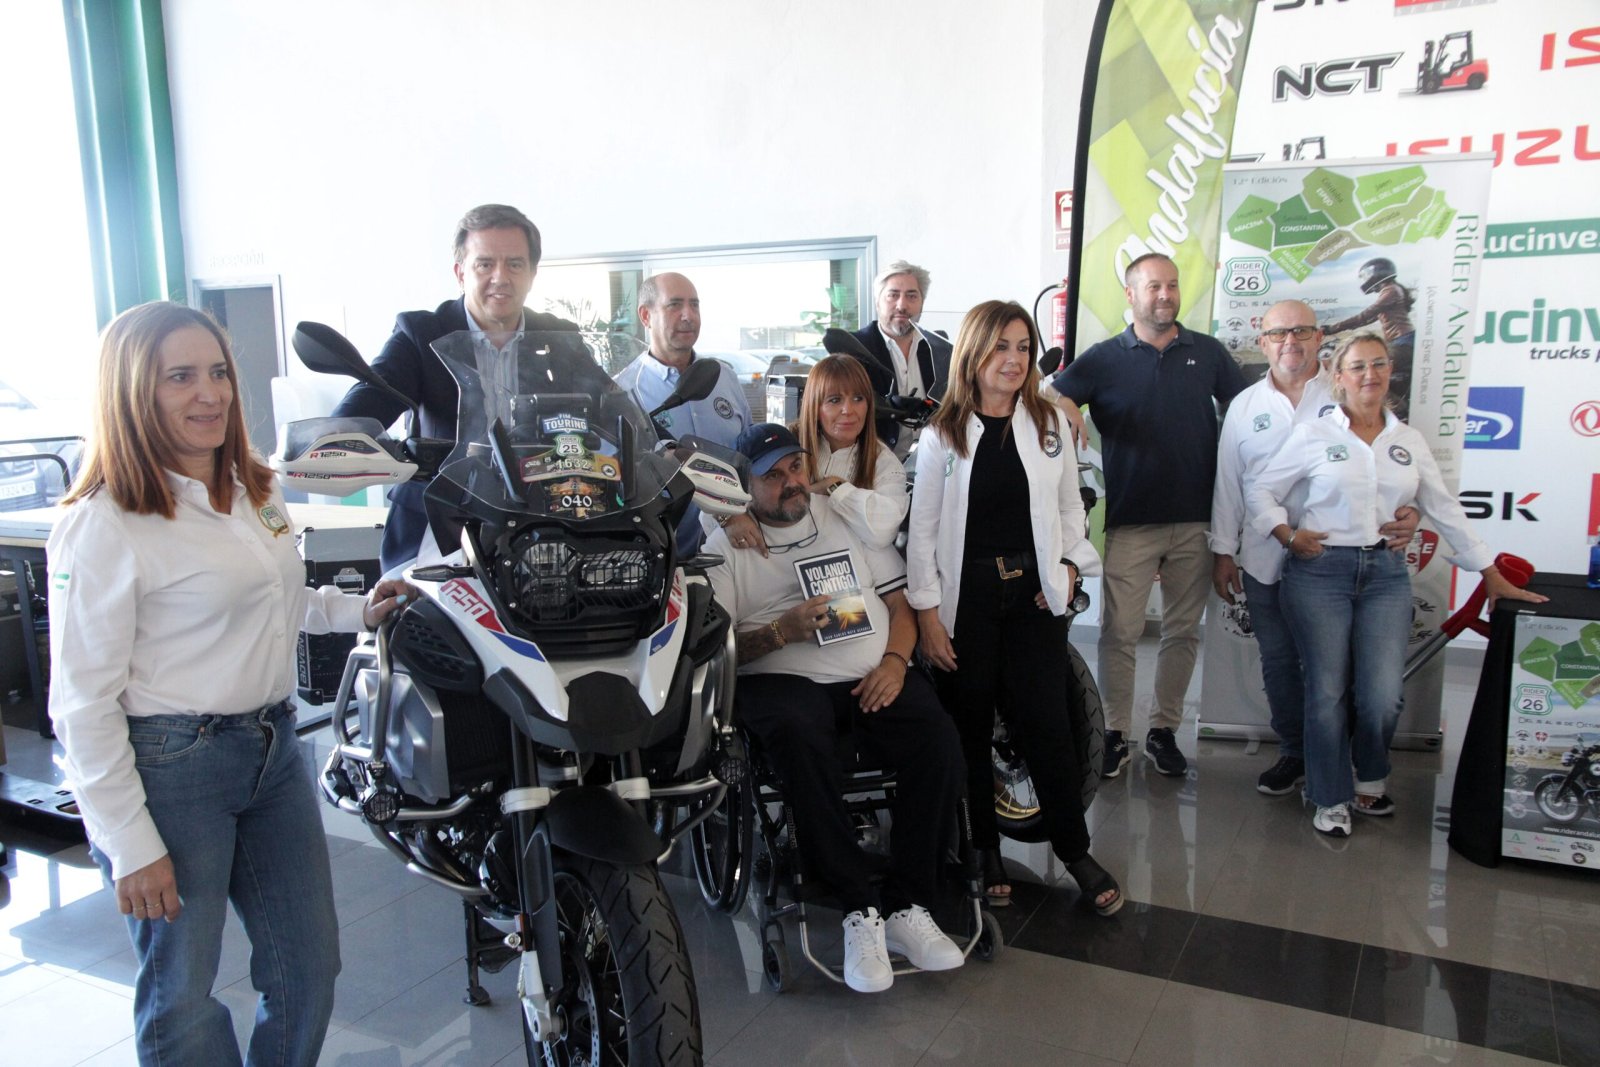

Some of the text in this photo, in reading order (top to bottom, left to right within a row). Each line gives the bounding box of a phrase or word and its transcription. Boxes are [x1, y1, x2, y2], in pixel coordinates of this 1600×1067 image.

[1272, 51, 1405, 103] NCT
[1233, 219, 1264, 233] ARACENA
[1279, 224, 1329, 233] CONSTANTINA
[1484, 227, 1600, 253] ucinve
[1233, 262, 1261, 270] RIDER
[1233, 276, 1259, 291] 26
[1530, 346, 1591, 360] trucks
[543, 419, 588, 431] TOURING
[562, 444, 579, 454] 25
[558, 459, 589, 470] 1632
[561, 495, 593, 508] 040
[1458, 490, 1542, 522] SK
[805, 560, 851, 582] VOLANDO
[810, 573, 855, 596] CONTIGO
[442, 580, 490, 621] 1250
[1523, 687, 1545, 695] RIDER
[1522, 698, 1543, 711] 26
